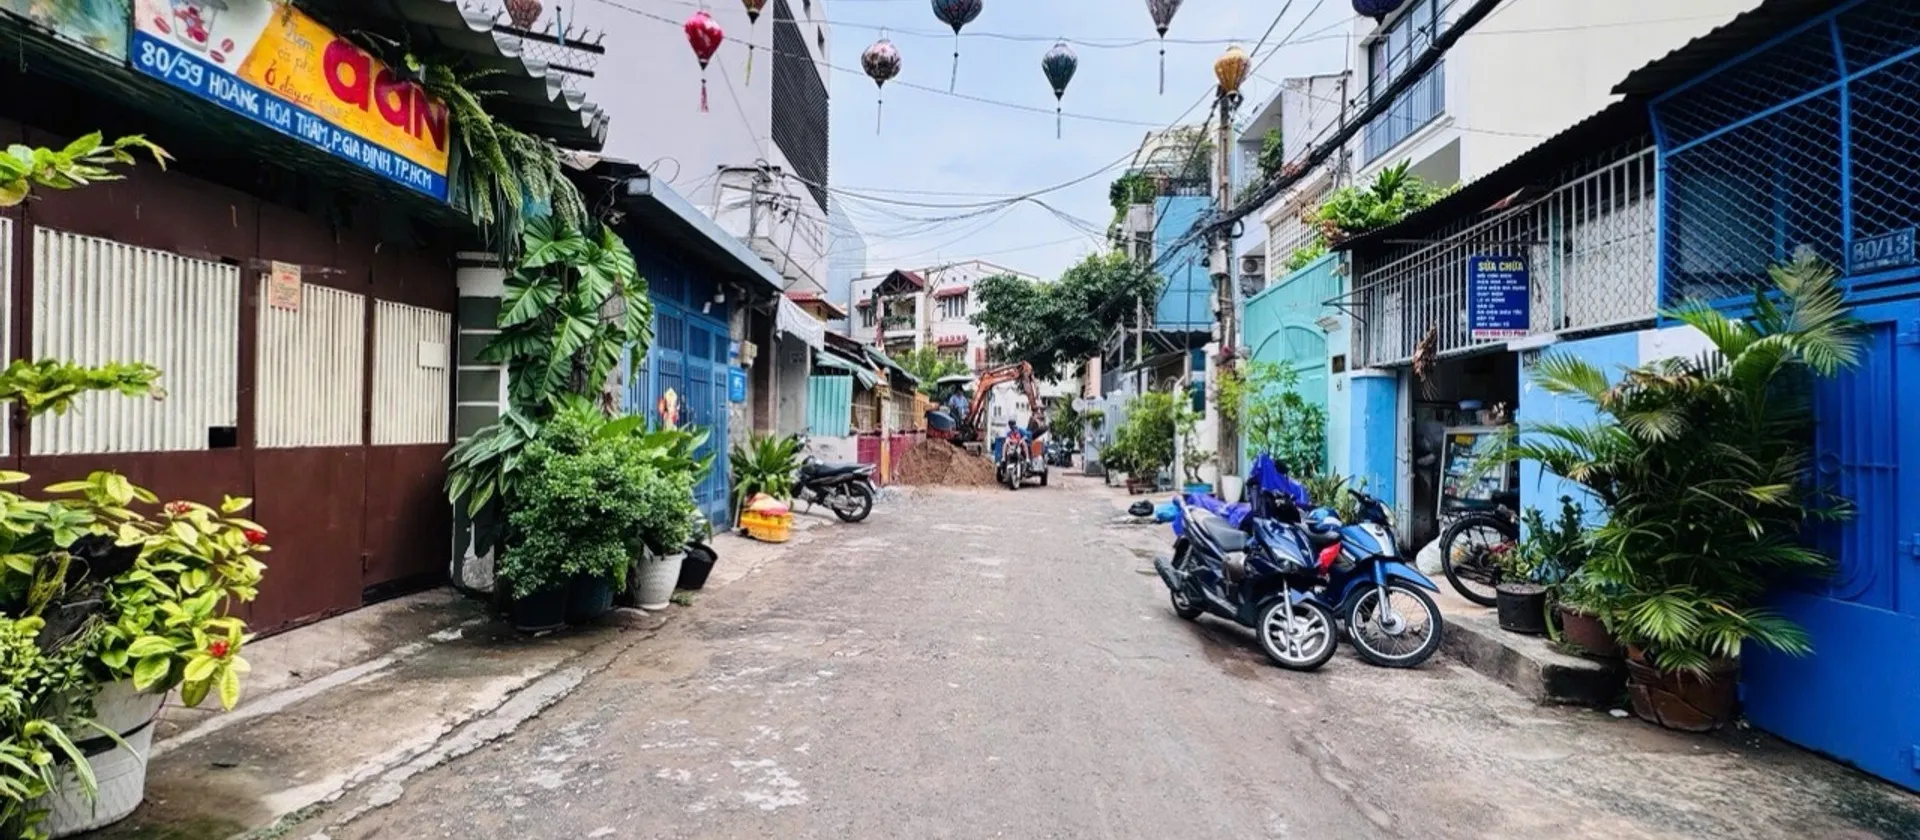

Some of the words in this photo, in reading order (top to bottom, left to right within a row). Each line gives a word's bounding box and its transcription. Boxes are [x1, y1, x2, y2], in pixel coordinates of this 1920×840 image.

[141, 41, 204, 87] 80/59
[265, 98, 291, 128] HOA
[1852, 232, 1910, 262] 80/13
